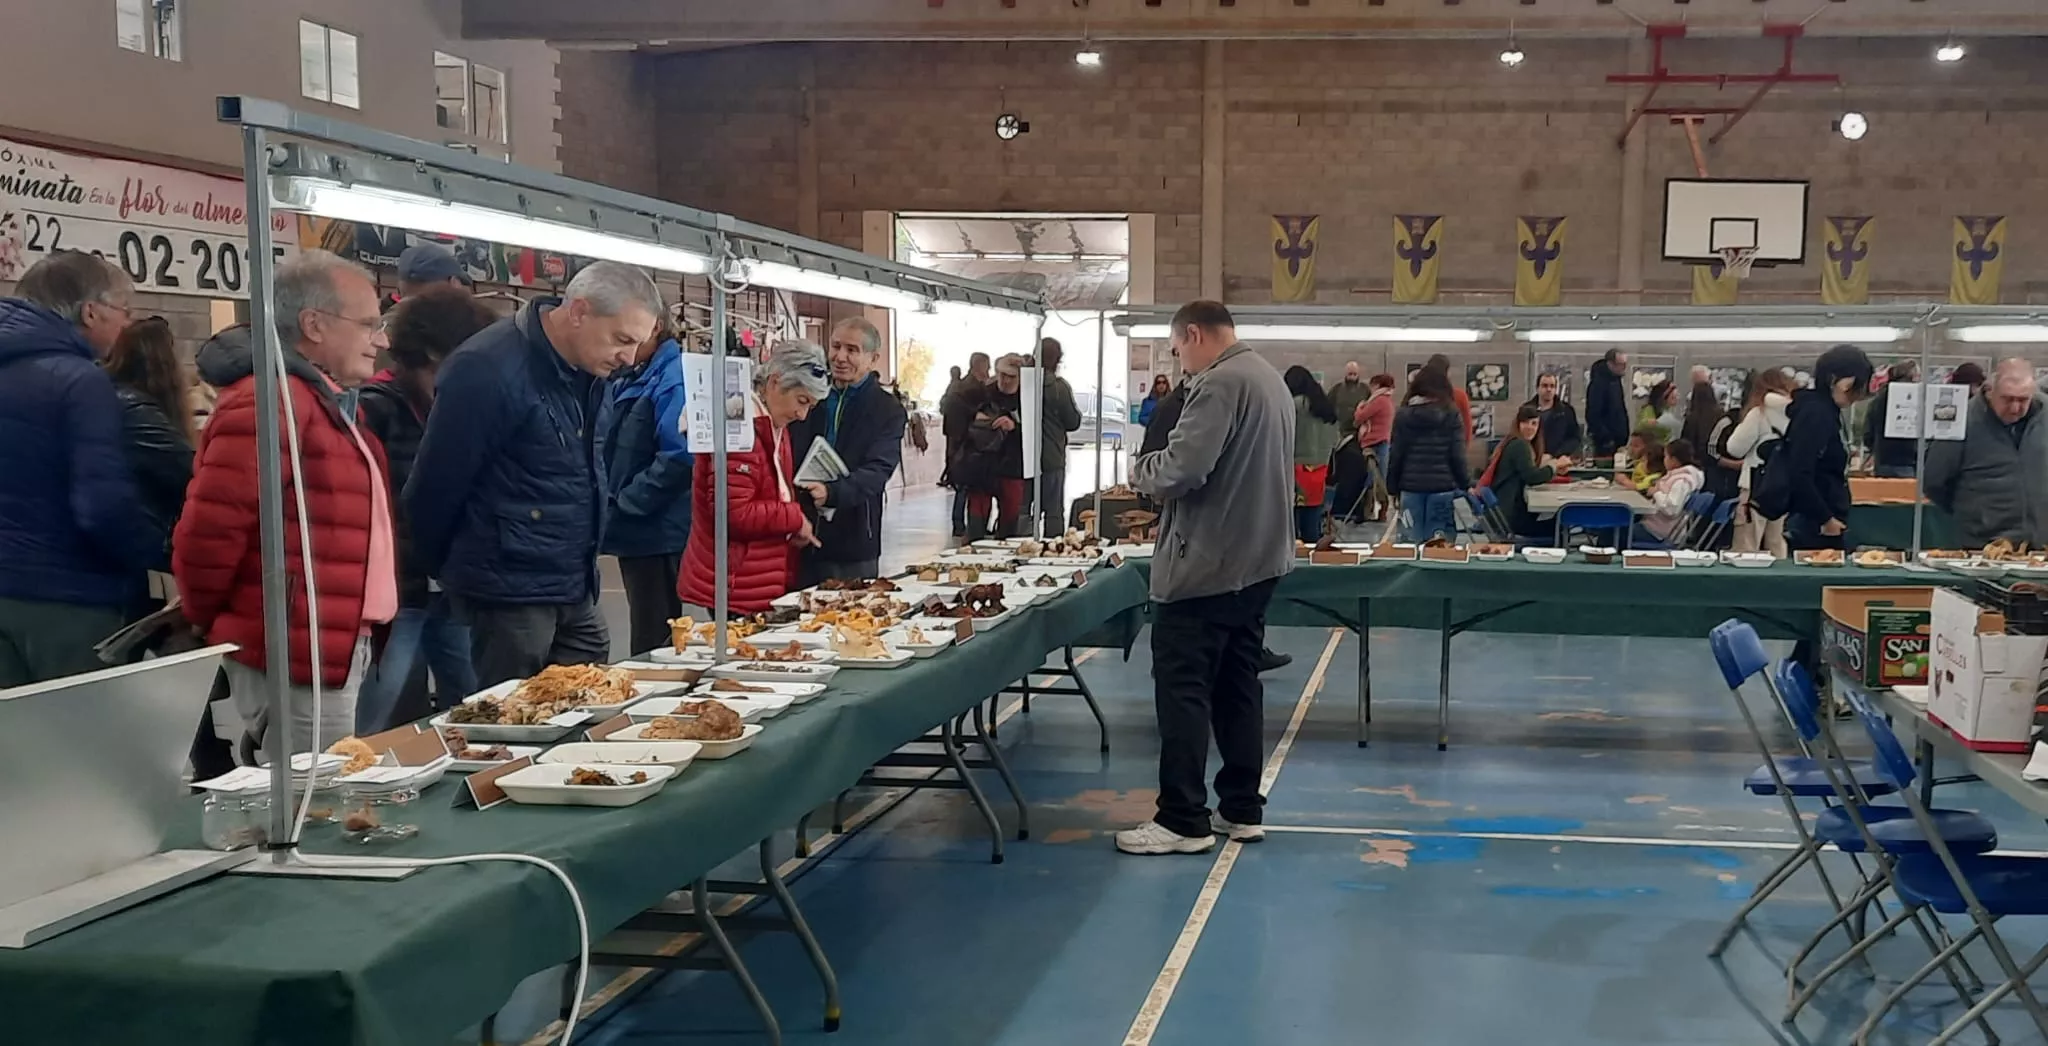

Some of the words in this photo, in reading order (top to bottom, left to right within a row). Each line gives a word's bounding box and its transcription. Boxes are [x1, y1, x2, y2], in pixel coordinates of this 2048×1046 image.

[118, 177, 169, 220] flor
[173, 203, 189, 214] del
[26, 213, 64, 252] 22
[1884, 638, 1923, 661] SAN
